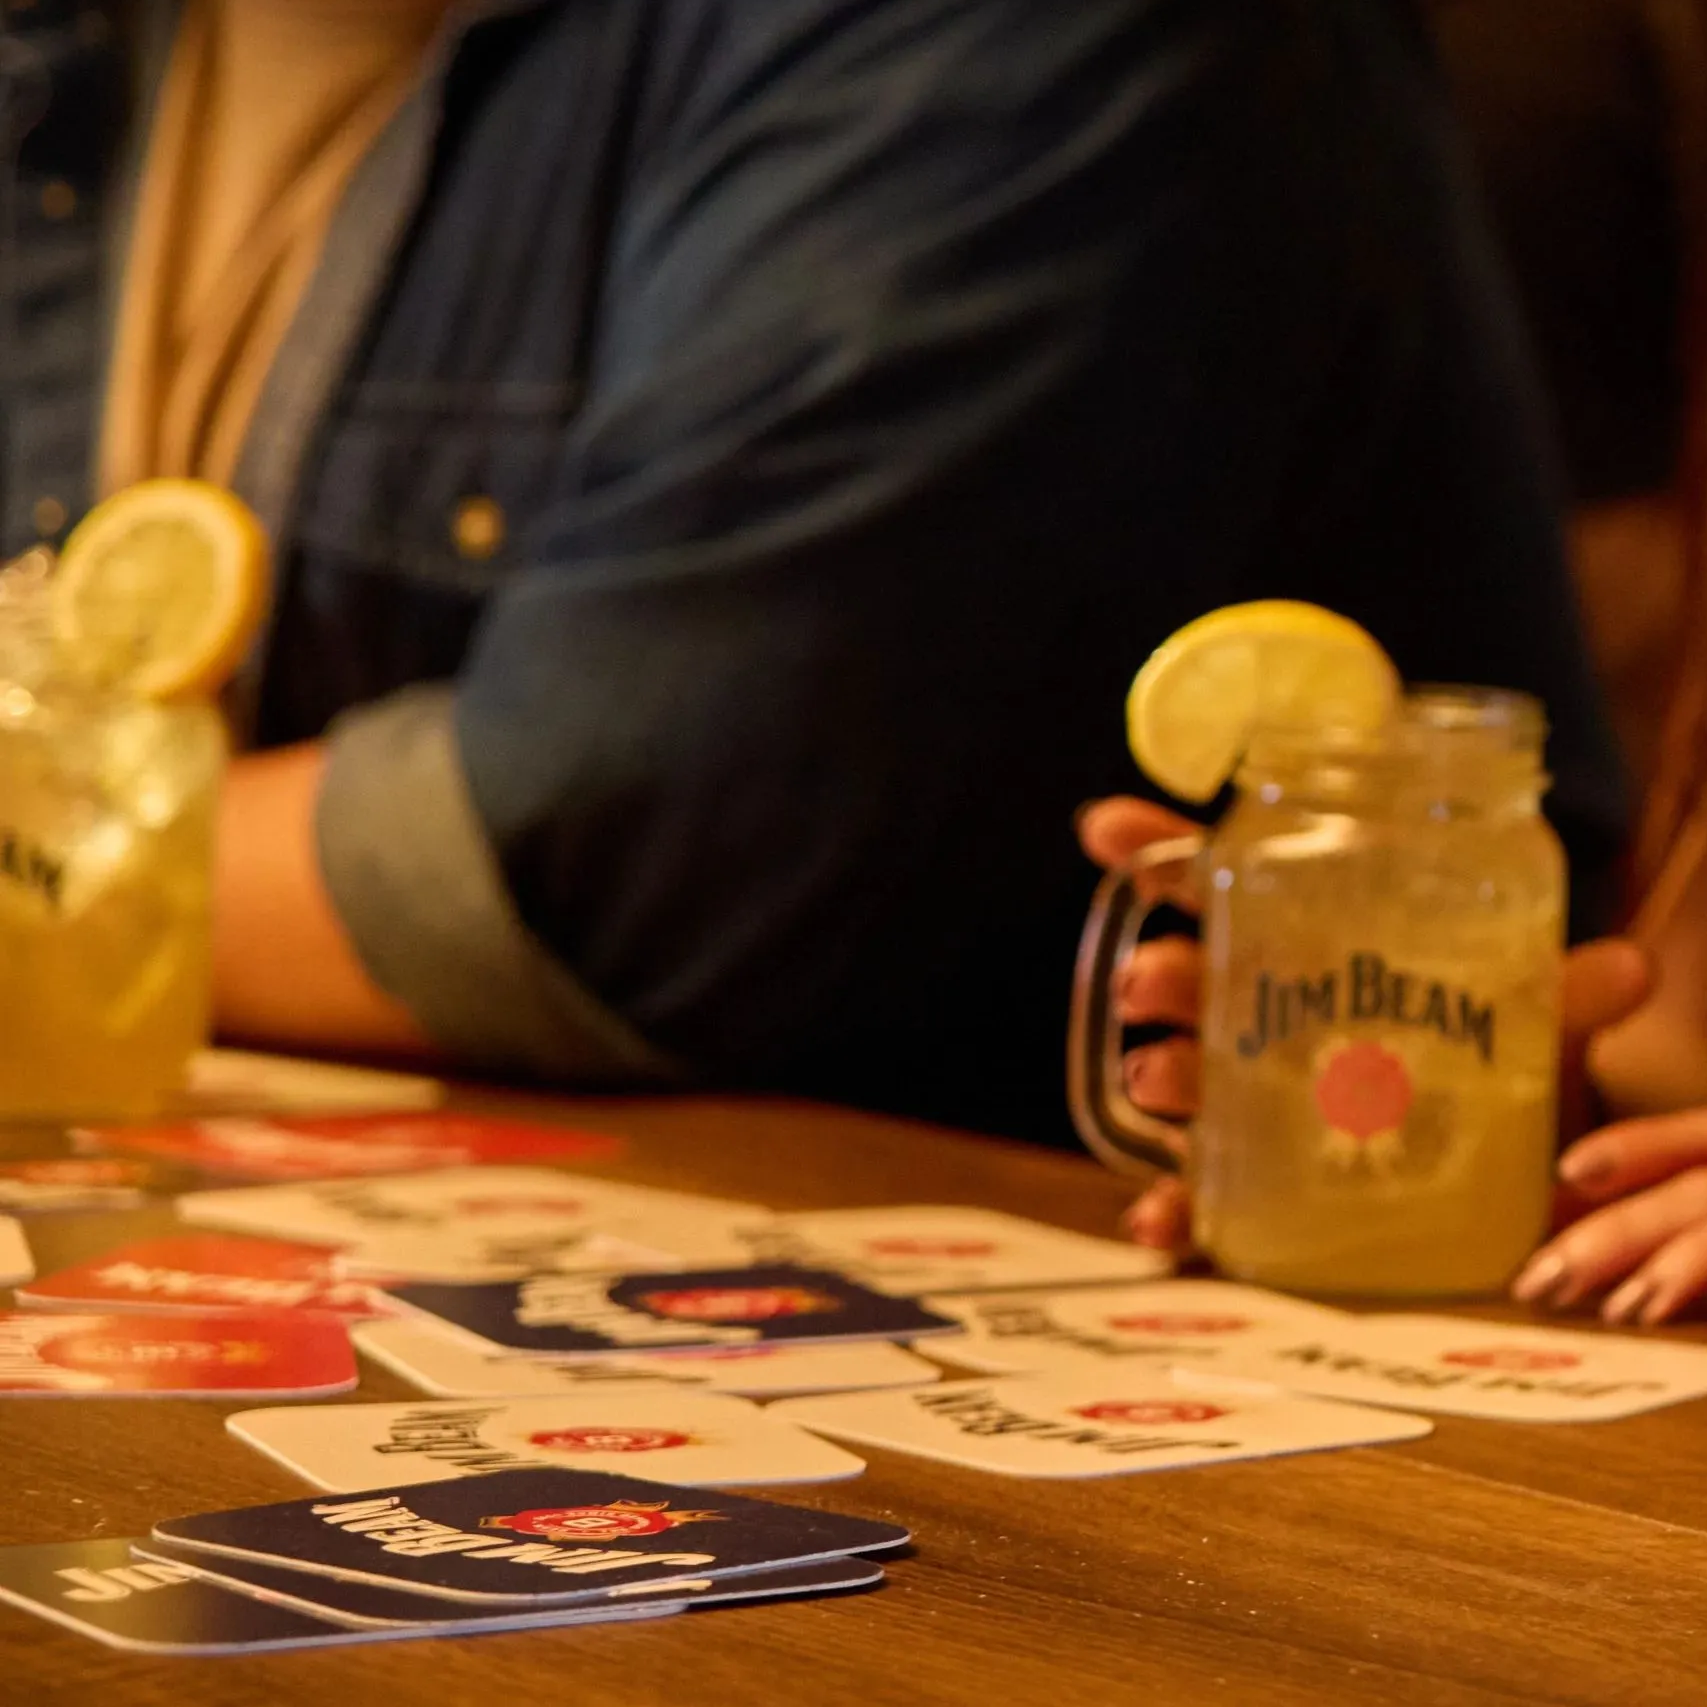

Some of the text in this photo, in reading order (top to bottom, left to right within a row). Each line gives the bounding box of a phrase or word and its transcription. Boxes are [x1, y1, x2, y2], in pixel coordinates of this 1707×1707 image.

[1236, 949, 1494, 1067] JIM BEAM
[312, 1495, 515, 1558] BEAM
[463, 1542, 717, 1574] JIM
